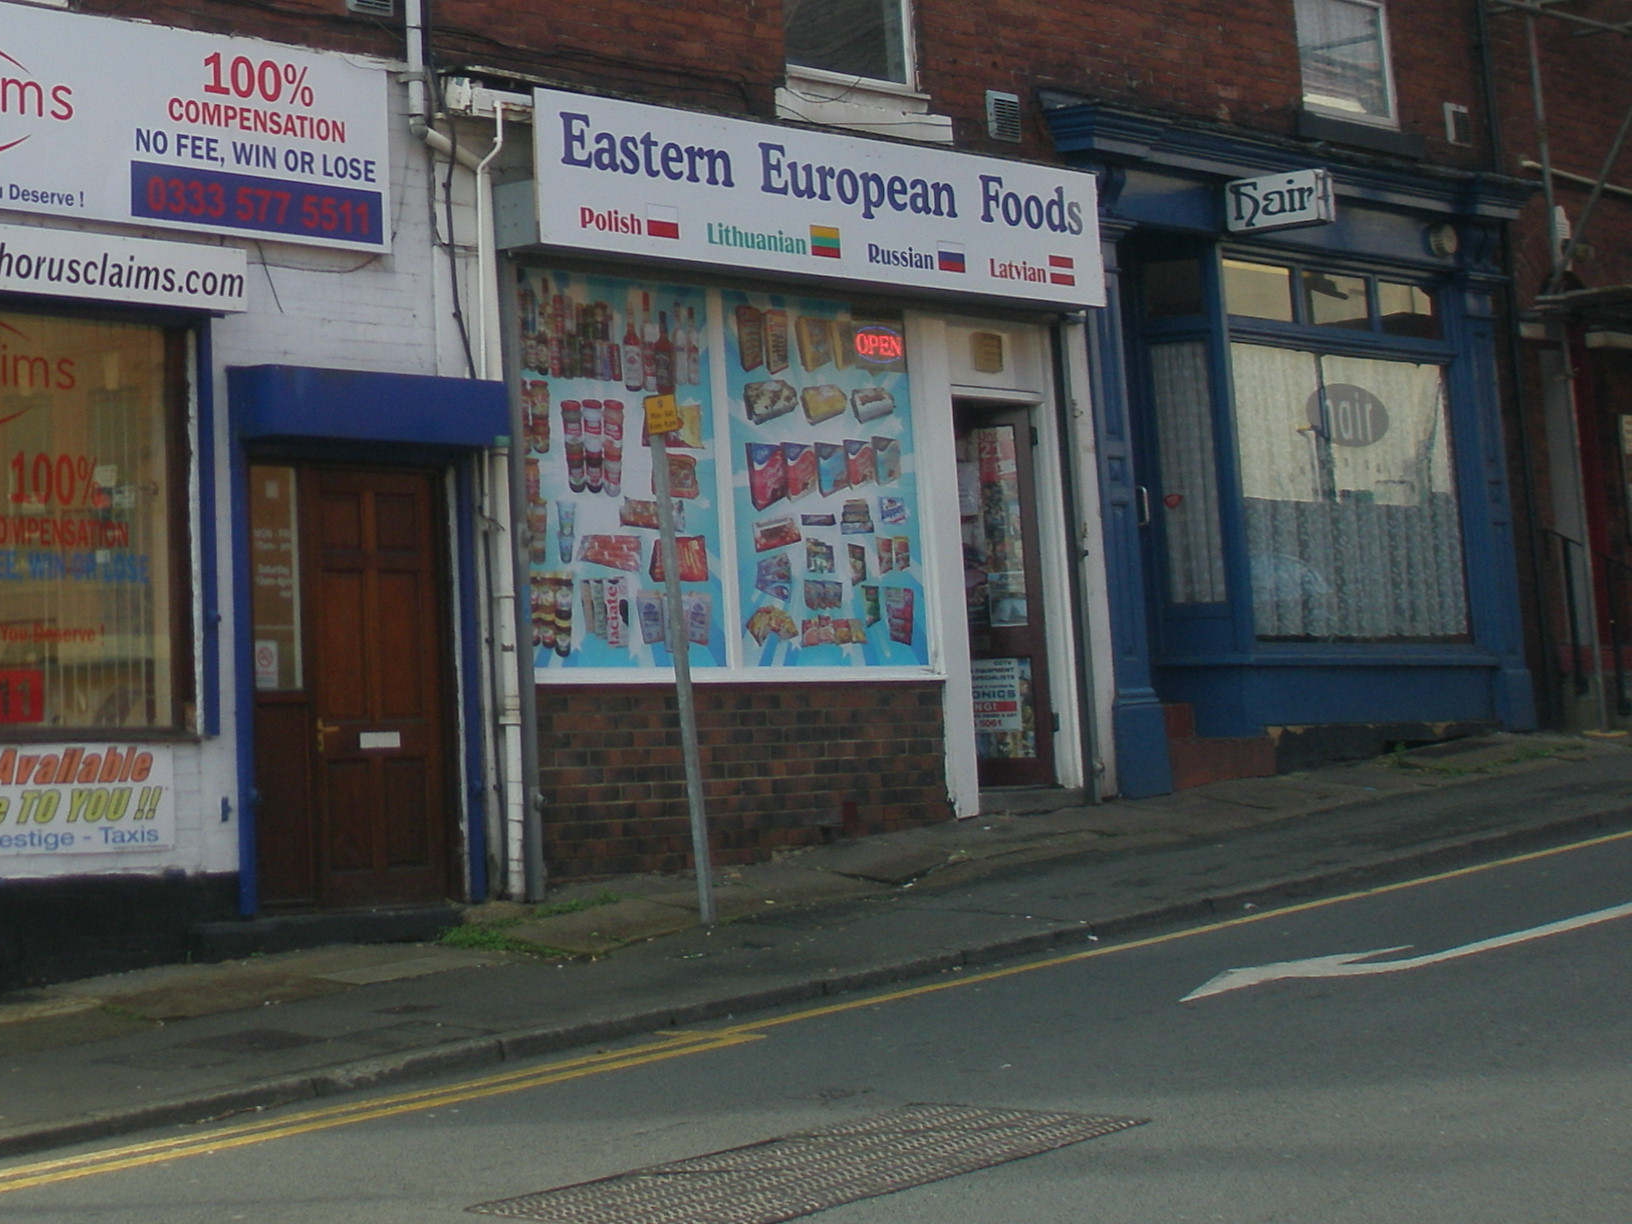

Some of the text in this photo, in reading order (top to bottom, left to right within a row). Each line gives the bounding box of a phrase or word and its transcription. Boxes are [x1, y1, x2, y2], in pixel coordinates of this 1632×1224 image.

[202, 52, 314, 109] 100%
[167, 97, 346, 145] COMPENSATION
[134, 127, 378, 184] NO FEE, WIN OR LOSE
[559, 110, 1084, 236] Eastern European Foods
[8, 182, 72, 208] Deserve
[147, 174, 371, 236] 0333 577 5511
[579, 205, 1047, 284] Polish Lithuanian Russian Latvian
[854, 332, 903, 358] OPEN
[980, 442, 1003, 459] 21
[10, 451, 110, 508] 100%
[15, 789, 64, 825] TO
[65, 786, 133, 823] YOU
[97, 826, 160, 845] Taxis
